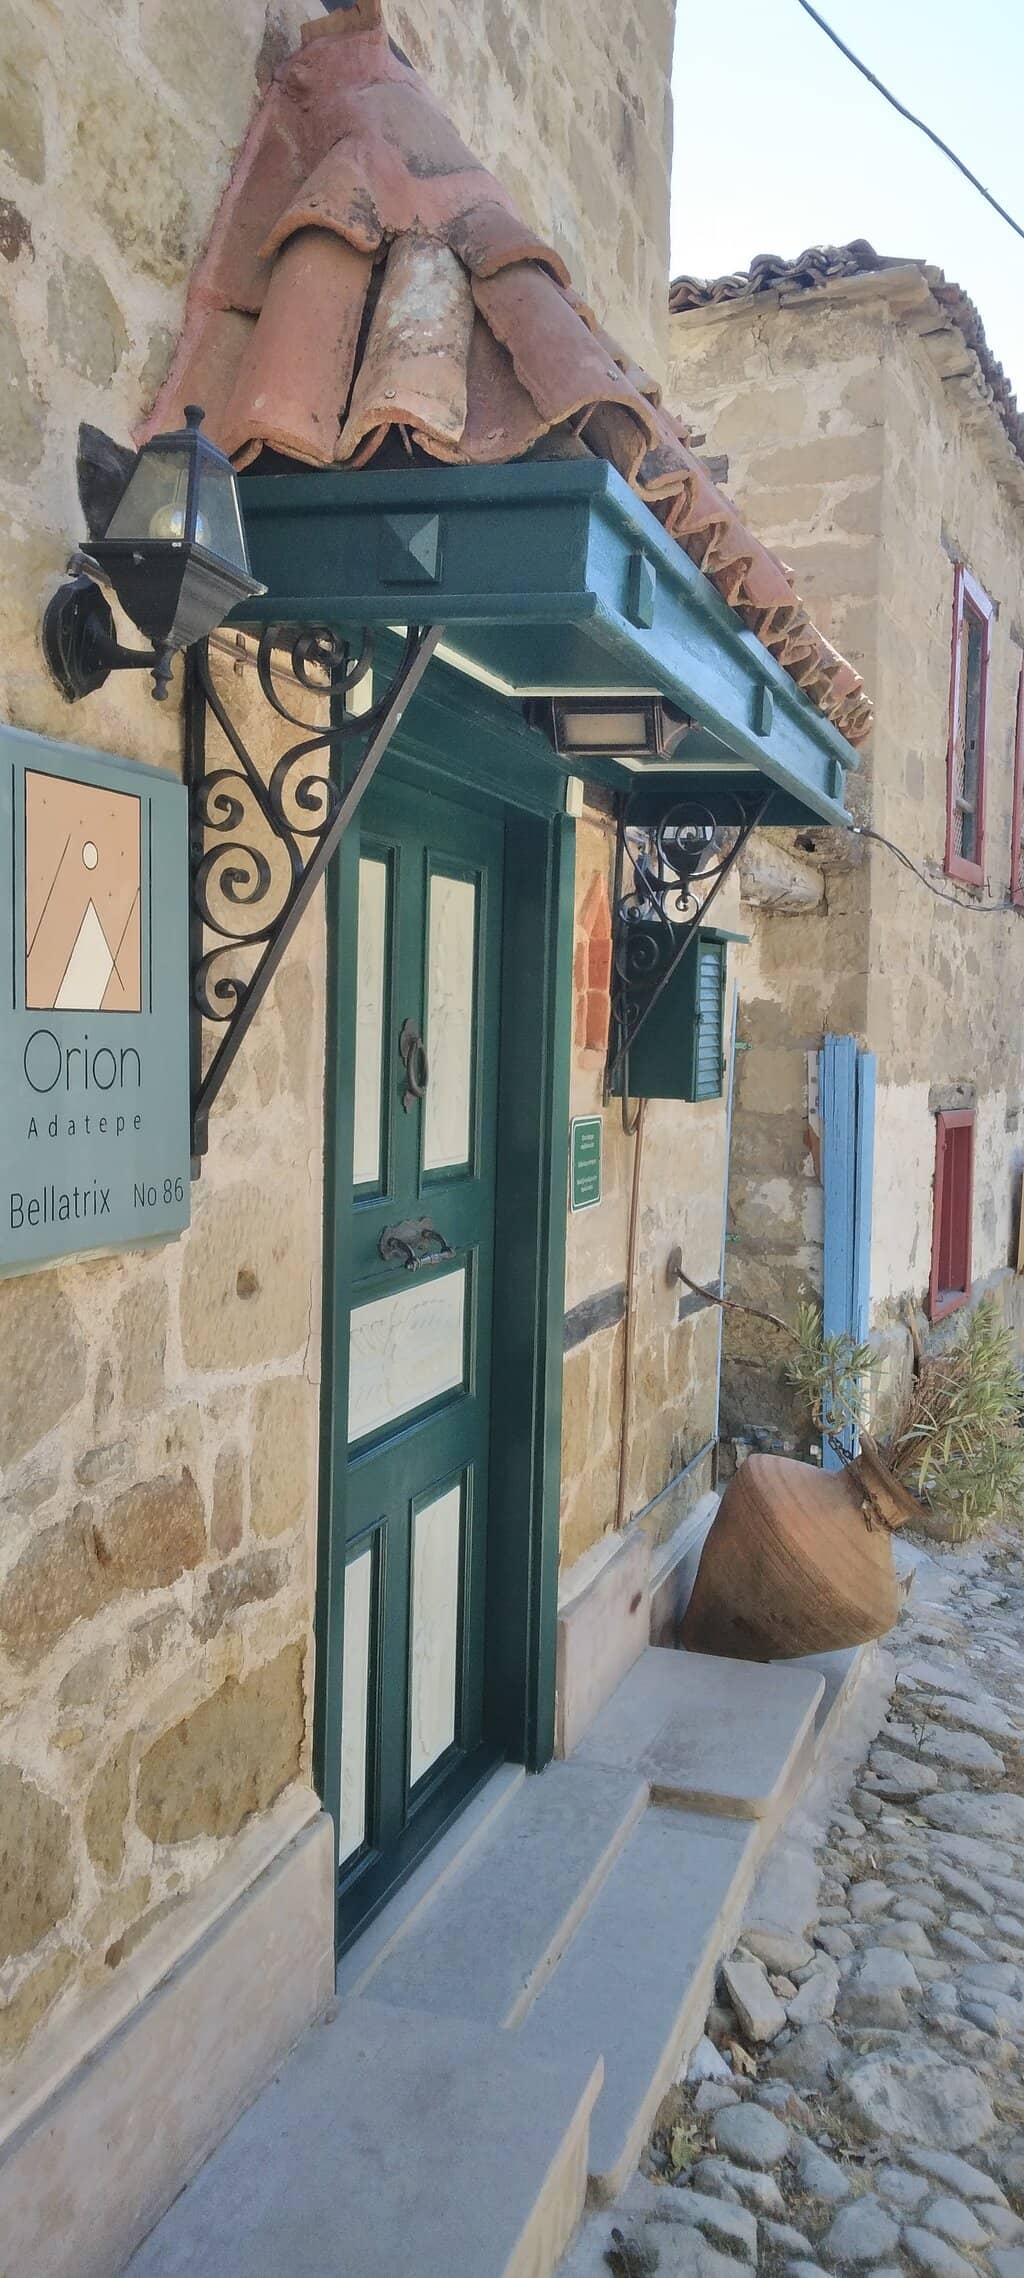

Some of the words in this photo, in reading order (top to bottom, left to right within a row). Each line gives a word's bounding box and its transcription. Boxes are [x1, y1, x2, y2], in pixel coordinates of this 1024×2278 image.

[23, 1029, 141, 1093] Orion
[27, 1113, 142, 1139] Adatepe
[10, 1179, 111, 1229] Bellatrix
[133, 1182, 157, 1208] No
[163, 1177, 184, 1205] 86
